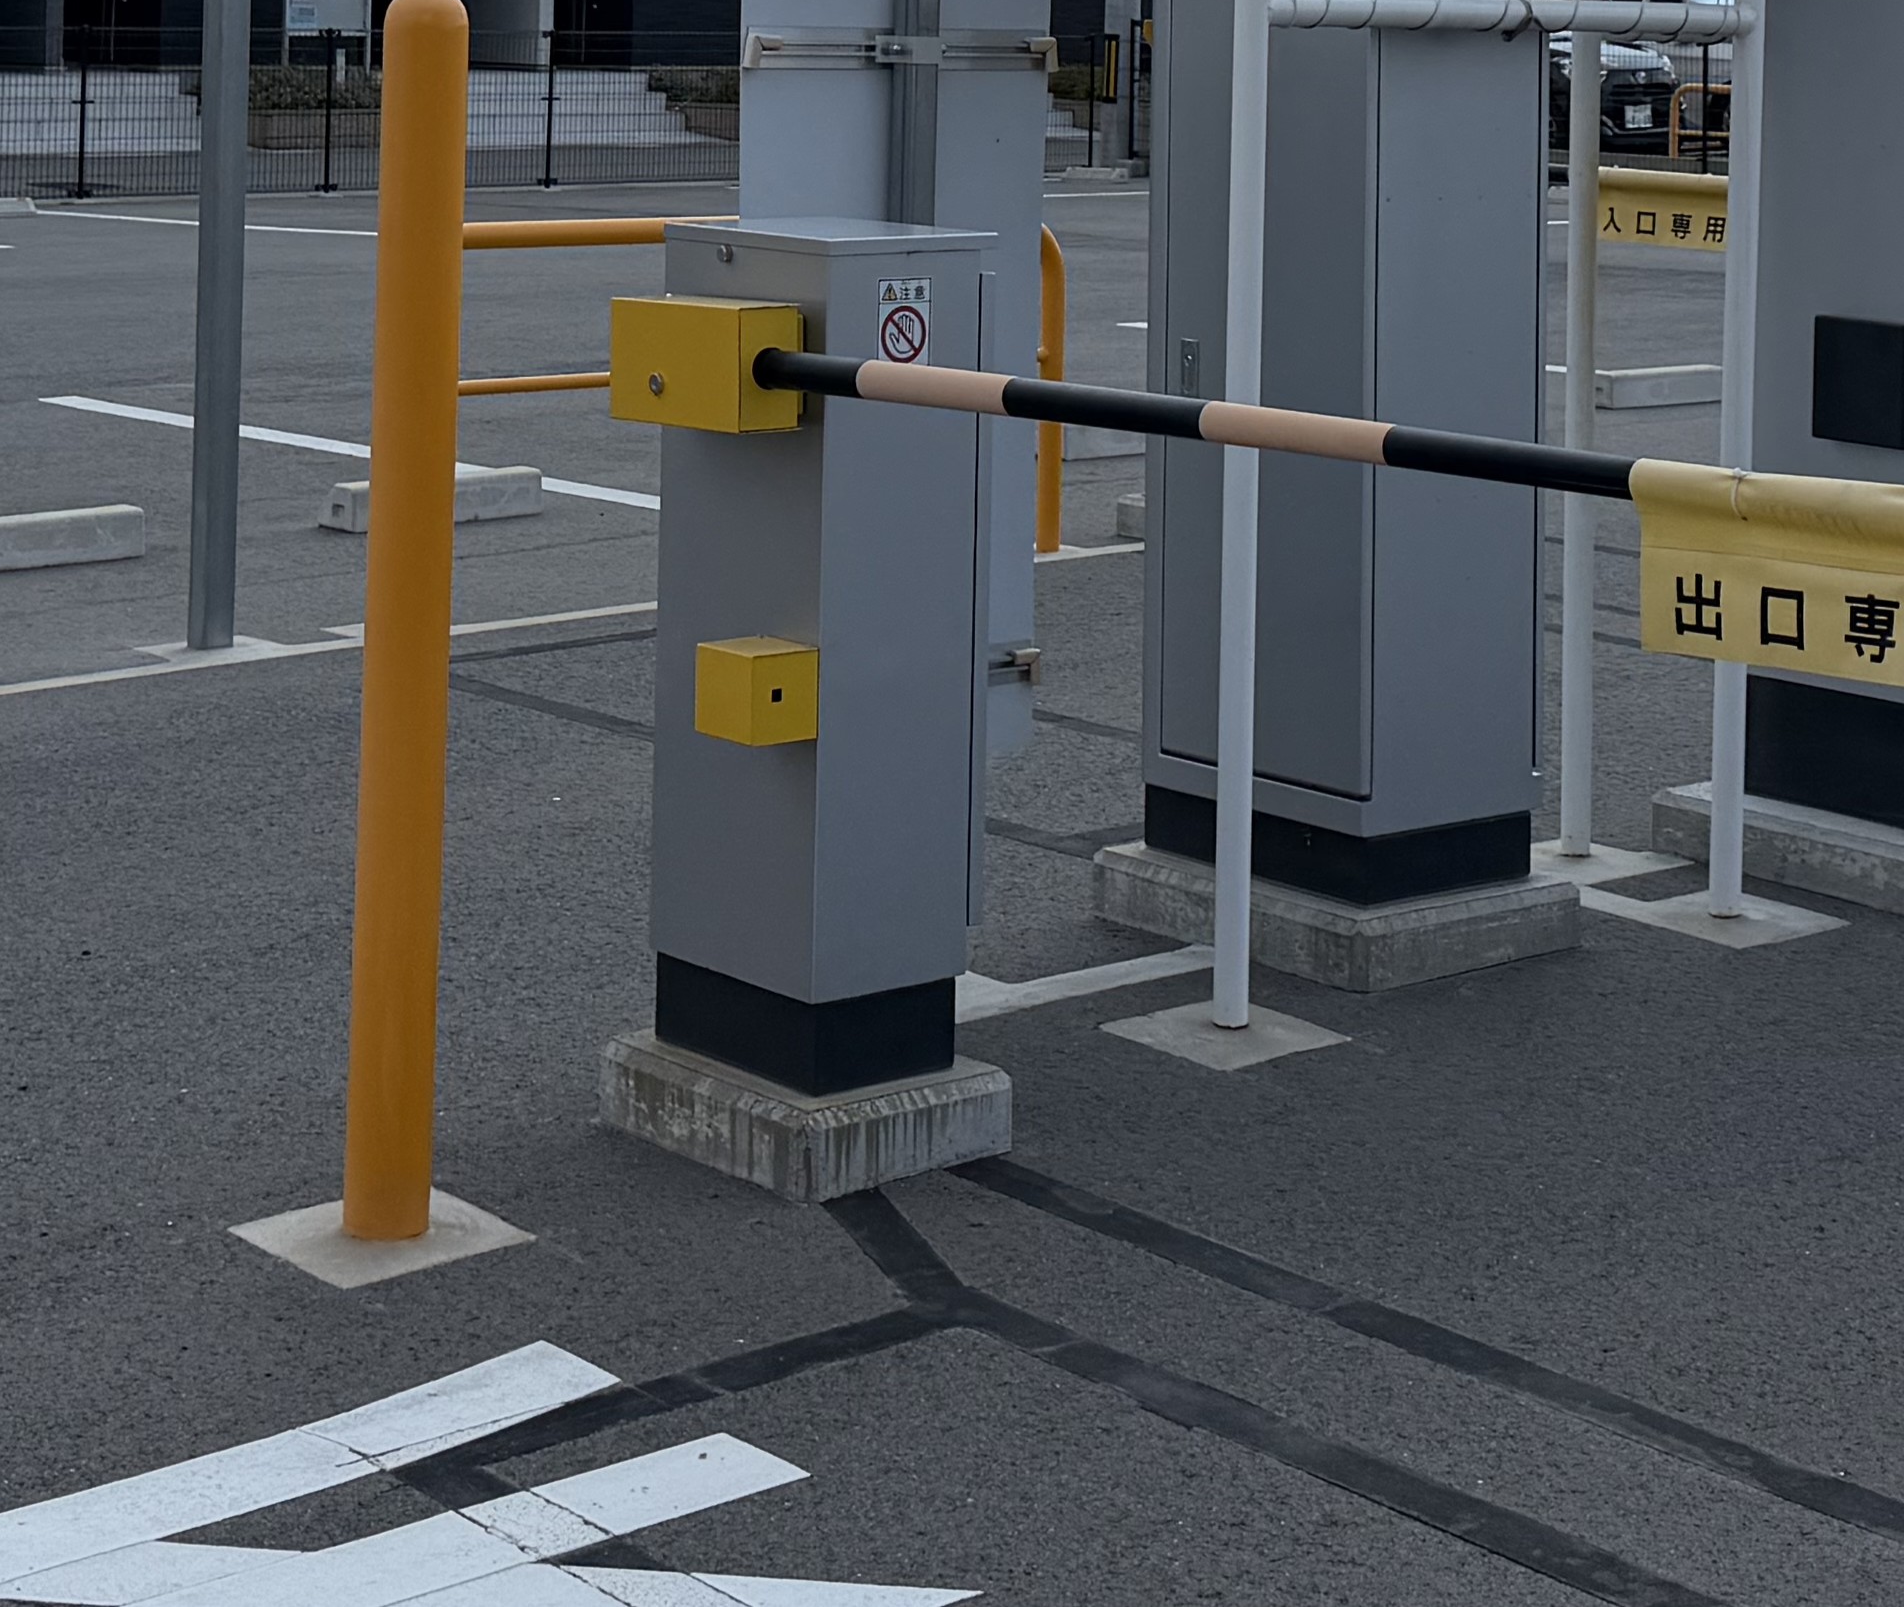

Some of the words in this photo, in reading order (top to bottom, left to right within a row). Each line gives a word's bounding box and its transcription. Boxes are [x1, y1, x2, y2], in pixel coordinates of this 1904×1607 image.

[1602, 206, 1727, 243] 入口専用
[899, 286, 925, 301] 注意
